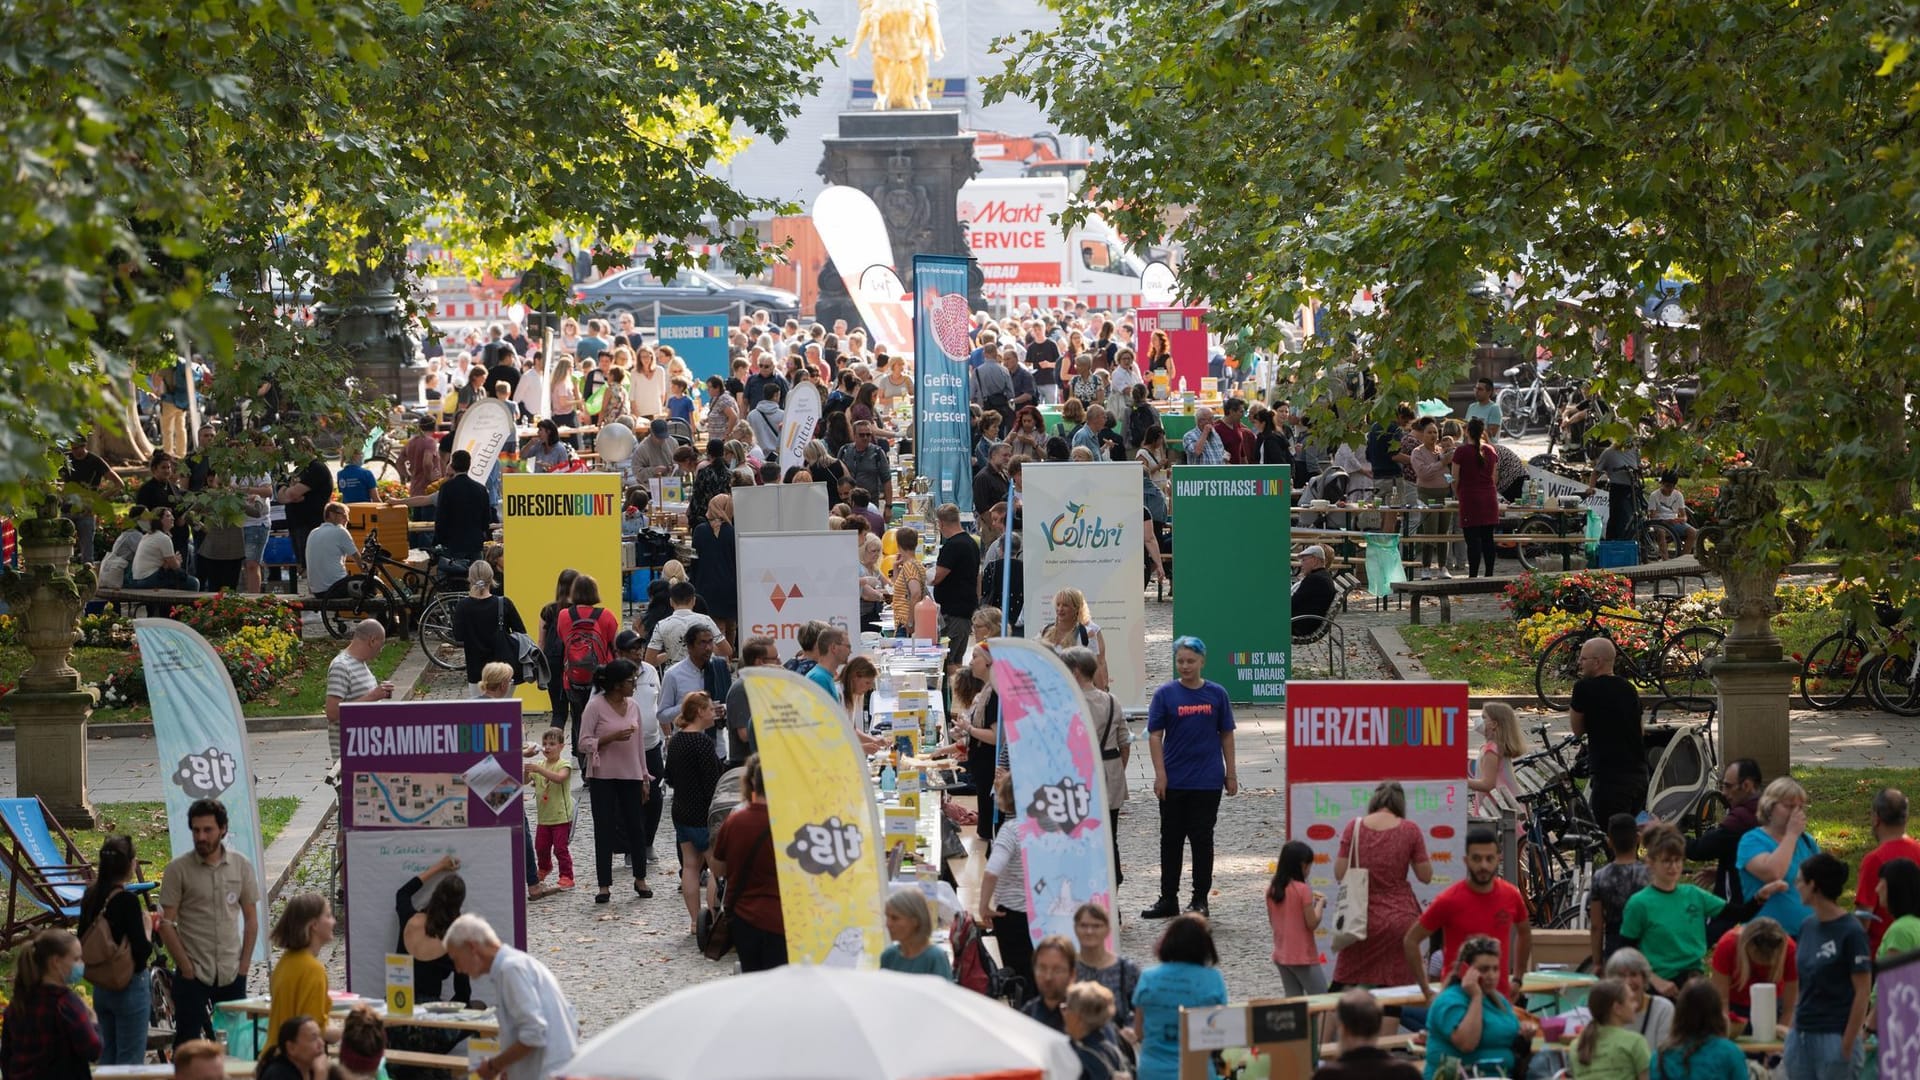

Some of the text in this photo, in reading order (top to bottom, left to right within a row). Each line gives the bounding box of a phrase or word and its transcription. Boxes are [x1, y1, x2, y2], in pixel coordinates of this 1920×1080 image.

[972, 201, 1044, 223] Markt
[969, 231, 1046, 249] ERVICE
[931, 392, 957, 406] Fest
[793, 415, 815, 459] Cultus
[471, 432, 503, 478] Cultus
[1176, 479, 1283, 497] HAUPTSTRASSEBUNT
[507, 494, 614, 516] DRESDENBUNT
[1040, 513, 1124, 552] Kolibri
[1251, 652, 1265, 667] IST,
[1267, 652, 1285, 665] WAS
[1237, 668, 1285, 680] WIR DARAUS
[1252, 684, 1286, 697] MACHEN
[1293, 707, 1459, 746] HERZENBUNT
[346, 723, 512, 757] ZUSAMMENBUNT
